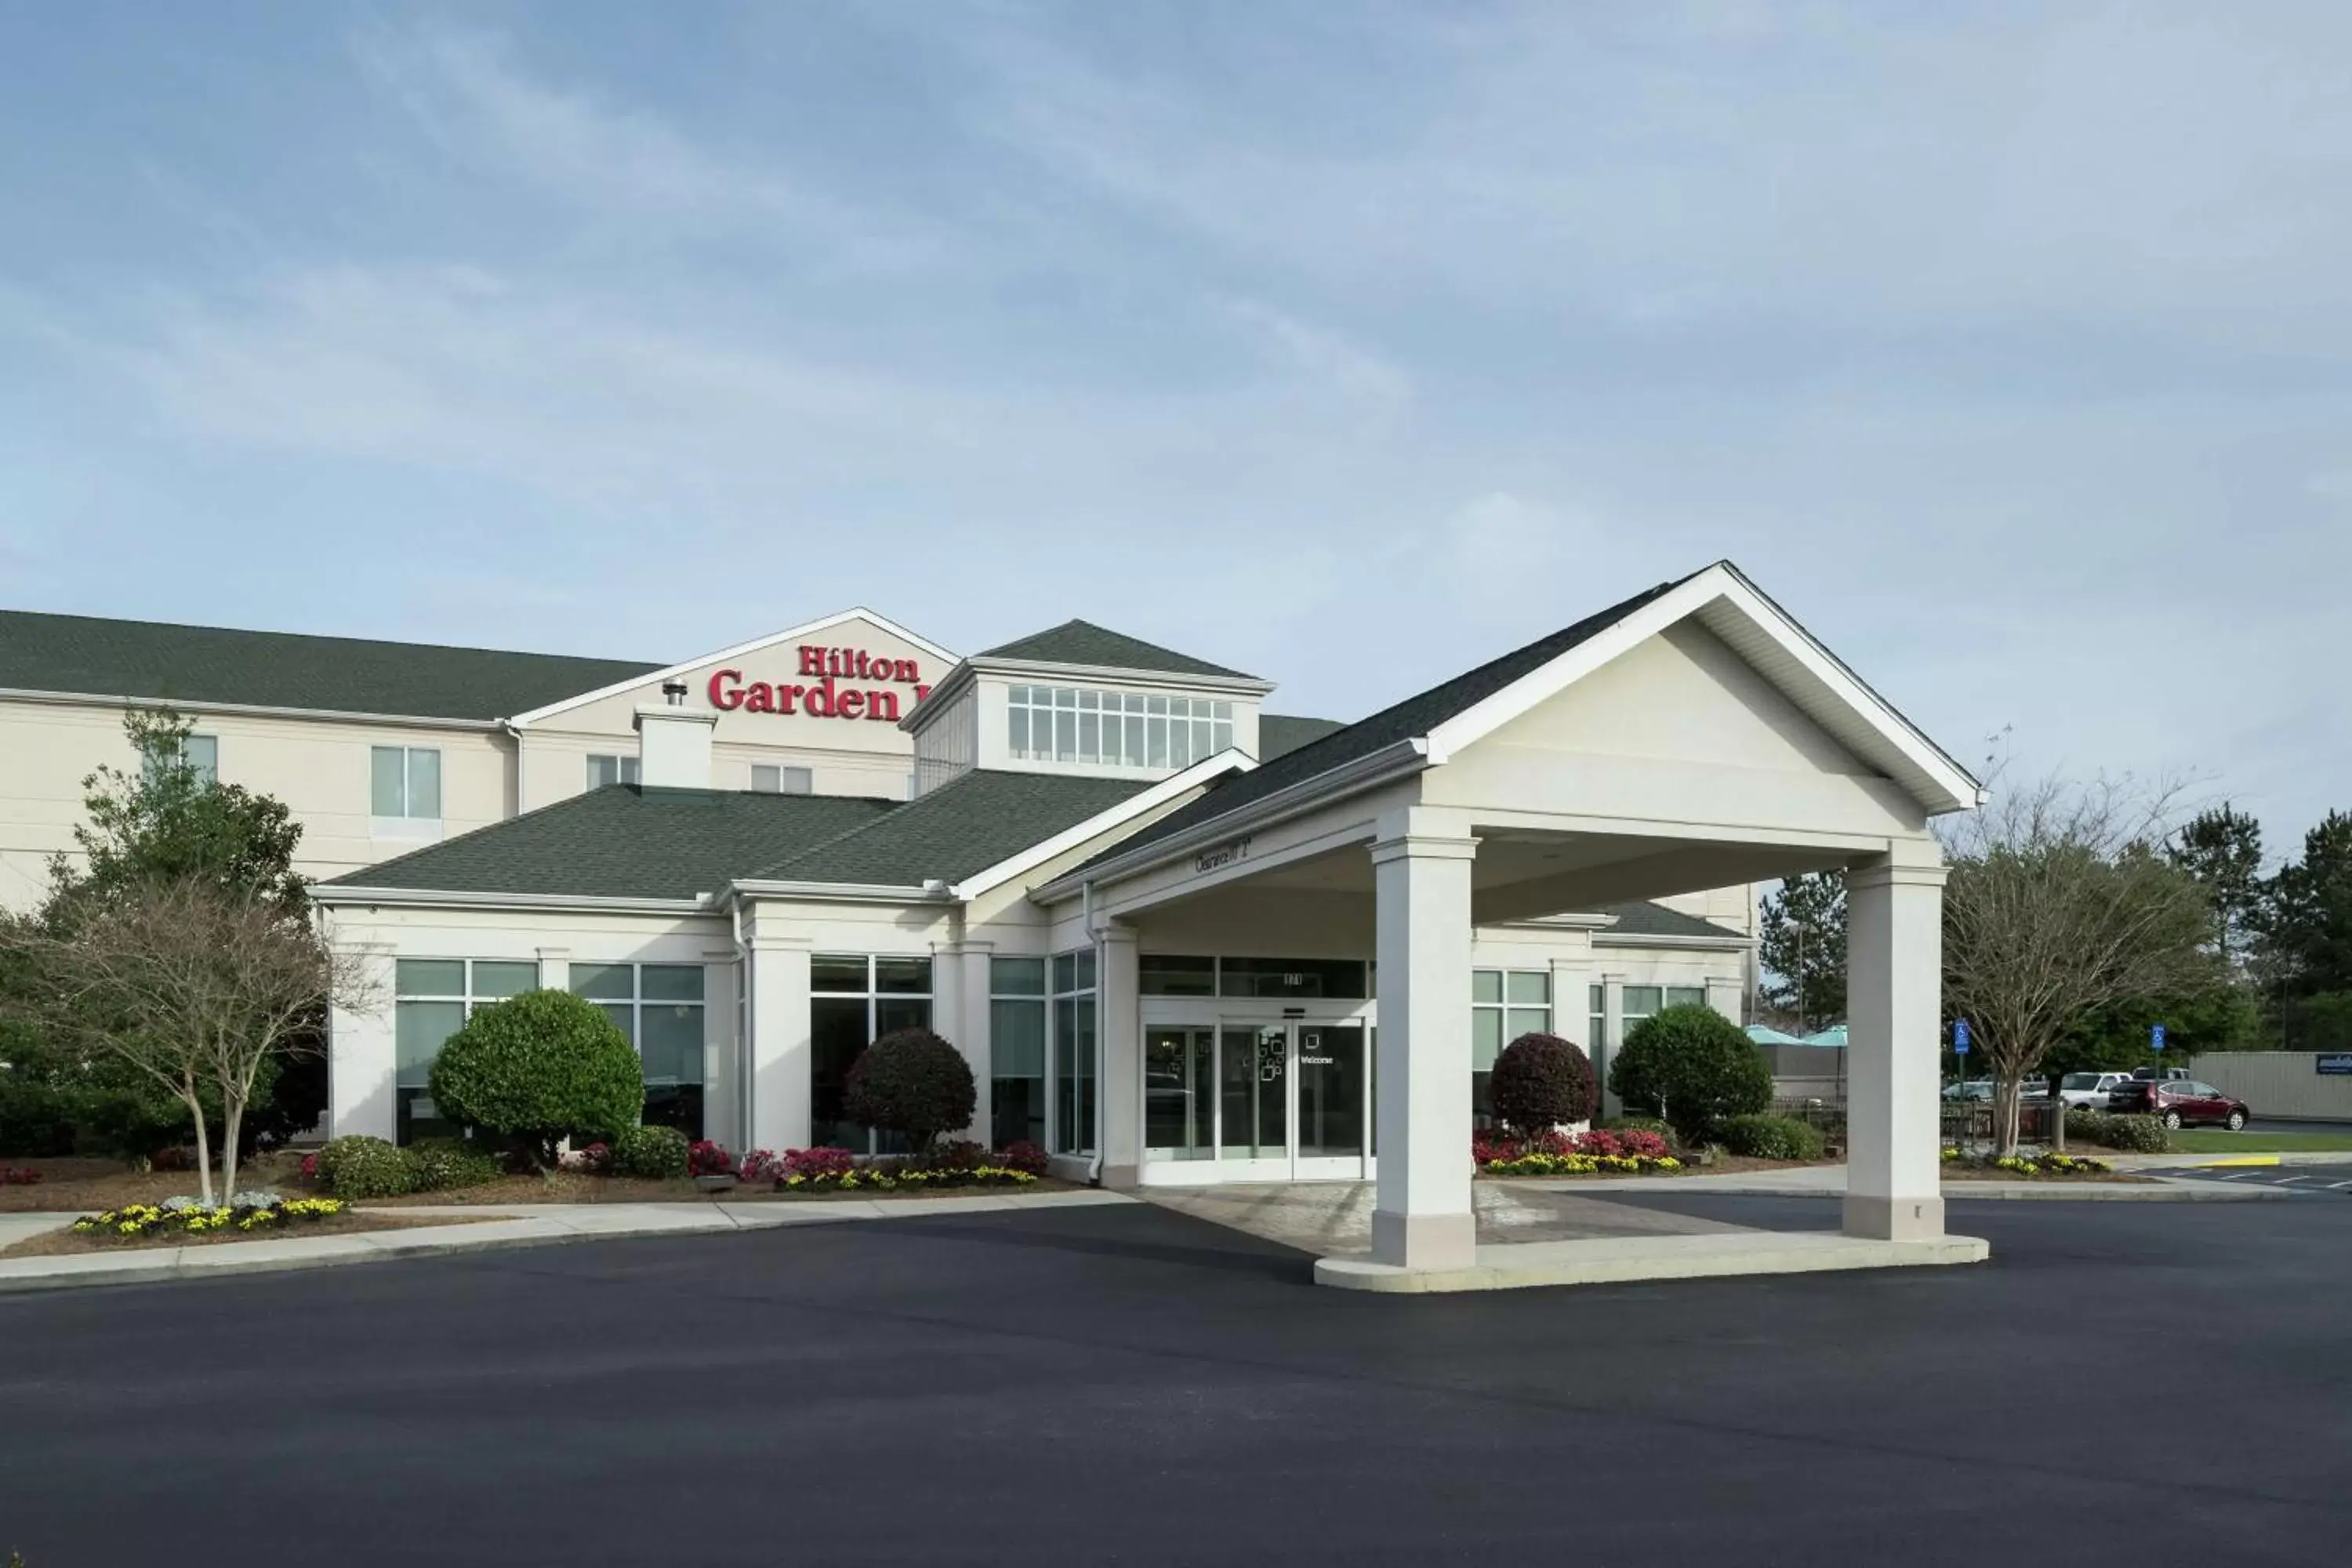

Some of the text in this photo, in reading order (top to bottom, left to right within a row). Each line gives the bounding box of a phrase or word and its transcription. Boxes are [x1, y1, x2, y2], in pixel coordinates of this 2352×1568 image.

[797, 645, 920, 683] Hilton
[708, 670, 902, 721] Garden
[1301, 1055, 1334, 1064] Welcome
